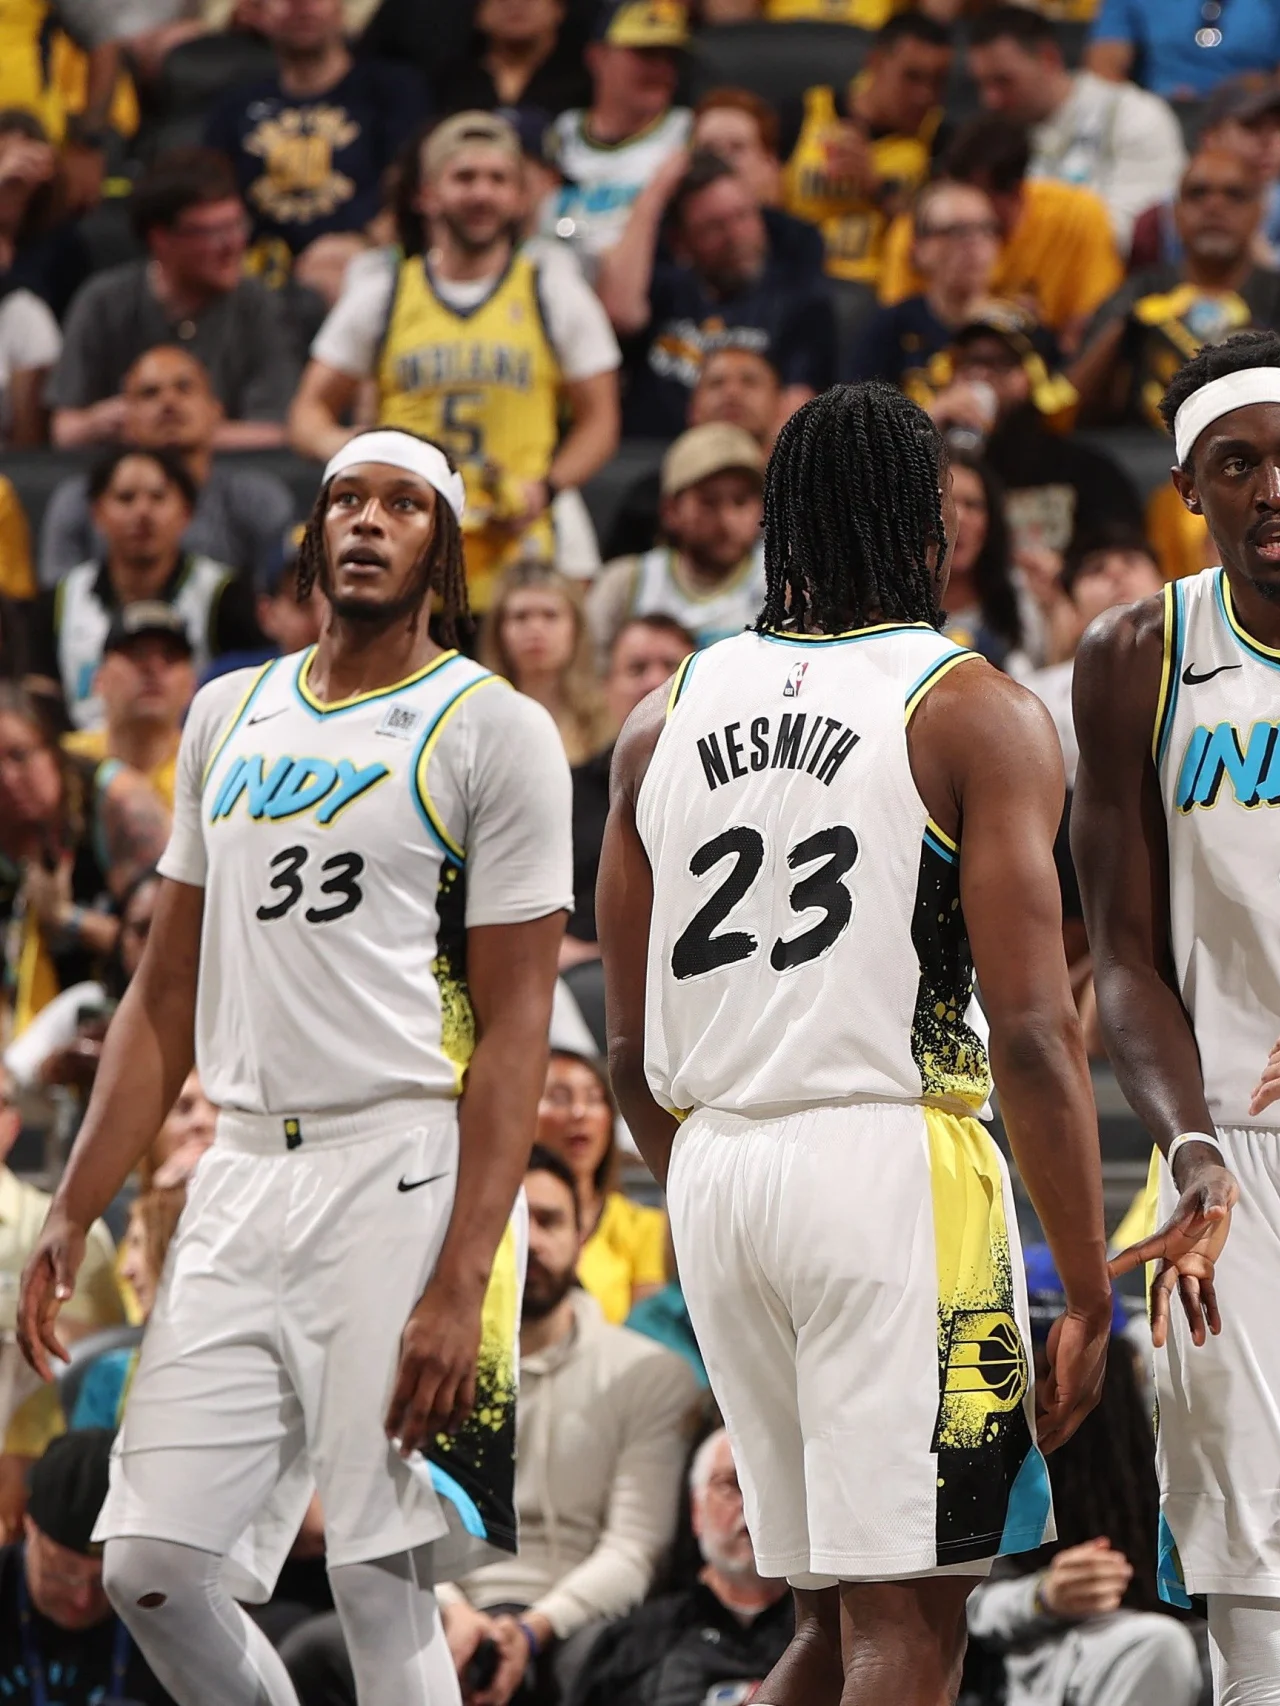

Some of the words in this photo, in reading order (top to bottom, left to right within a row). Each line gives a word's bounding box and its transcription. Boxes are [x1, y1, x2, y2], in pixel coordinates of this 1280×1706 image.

[441, 390, 484, 466] 5
[210, 754, 391, 828] INDY
[696, 713, 861, 791] NESMITH
[256, 845, 364, 923] 33
[671, 825, 859, 980] 23
